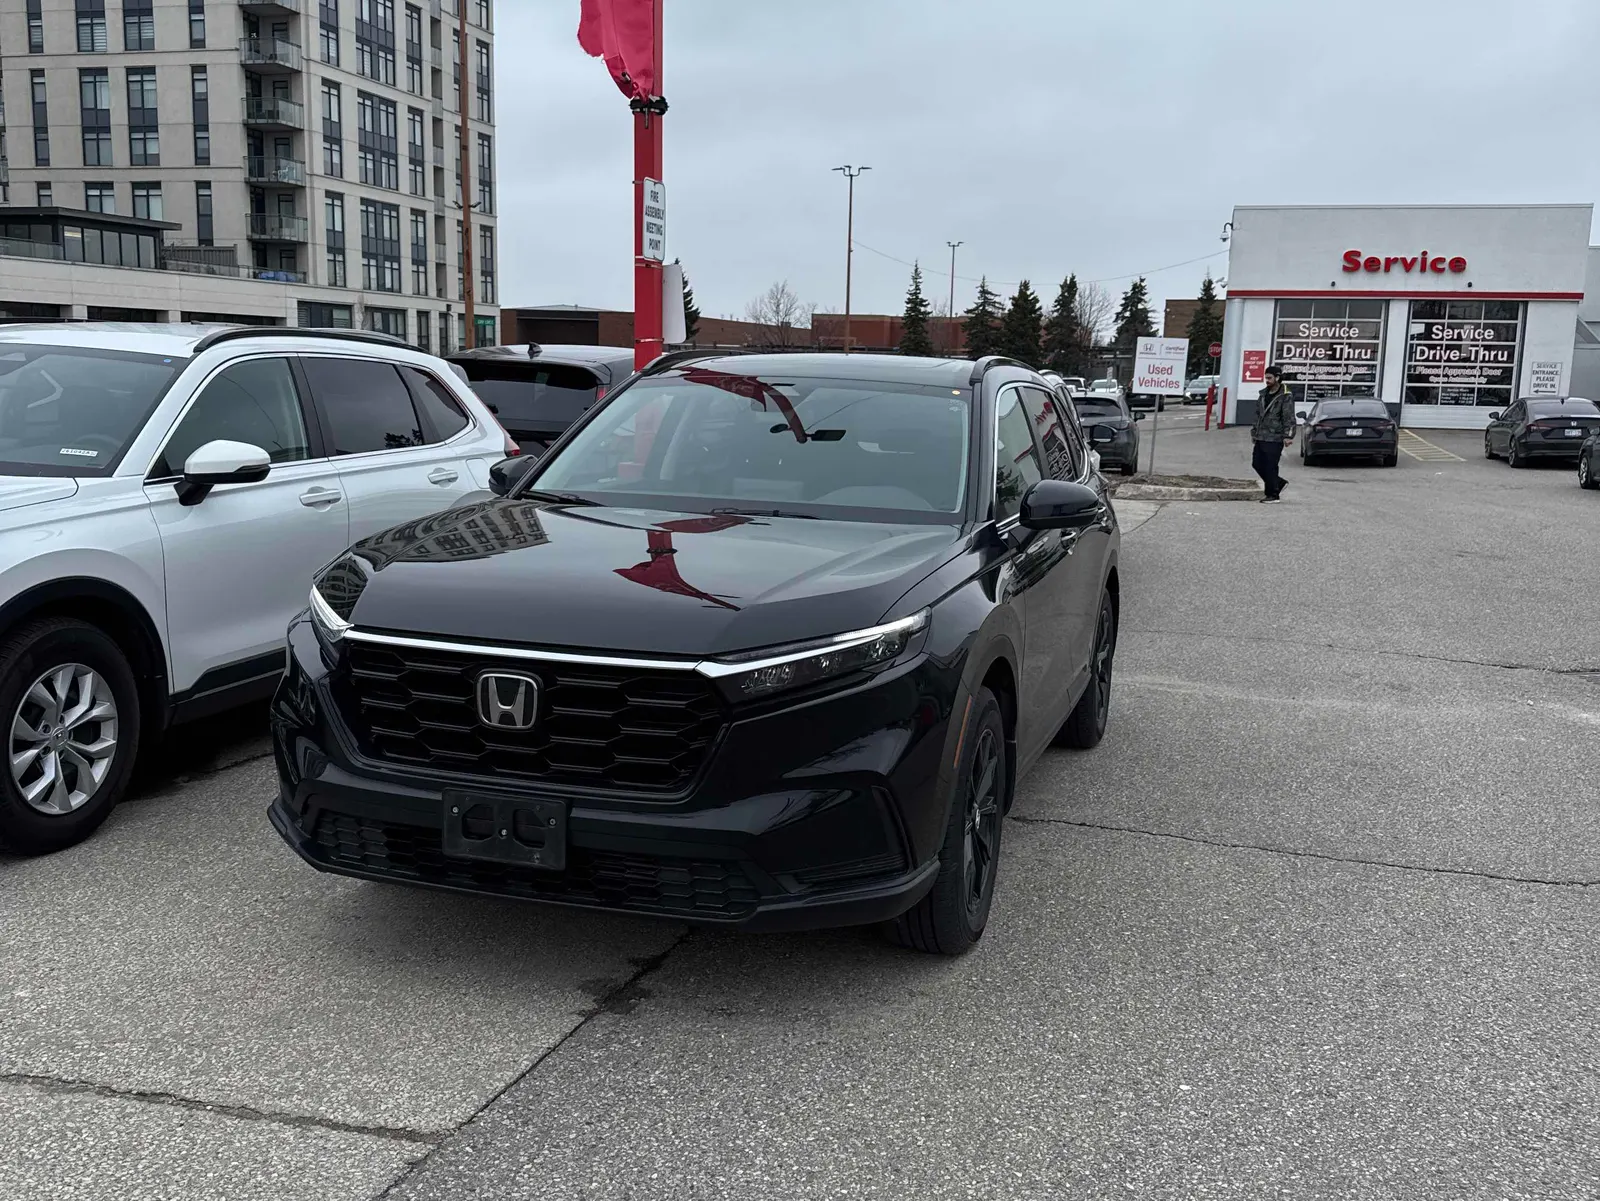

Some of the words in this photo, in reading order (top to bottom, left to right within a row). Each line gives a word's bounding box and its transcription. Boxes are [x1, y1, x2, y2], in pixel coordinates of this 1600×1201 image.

[1342, 250, 1467, 273] Service
[1298, 323, 1360, 338] Service
[1431, 325, 1495, 340] Service
[1282, 344, 1372, 359] Drive-Thru
[1415, 346, 1508, 361] Drive-Thru
[1148, 364, 1173, 375] Used
[1138, 376, 1180, 389] Vehicles
